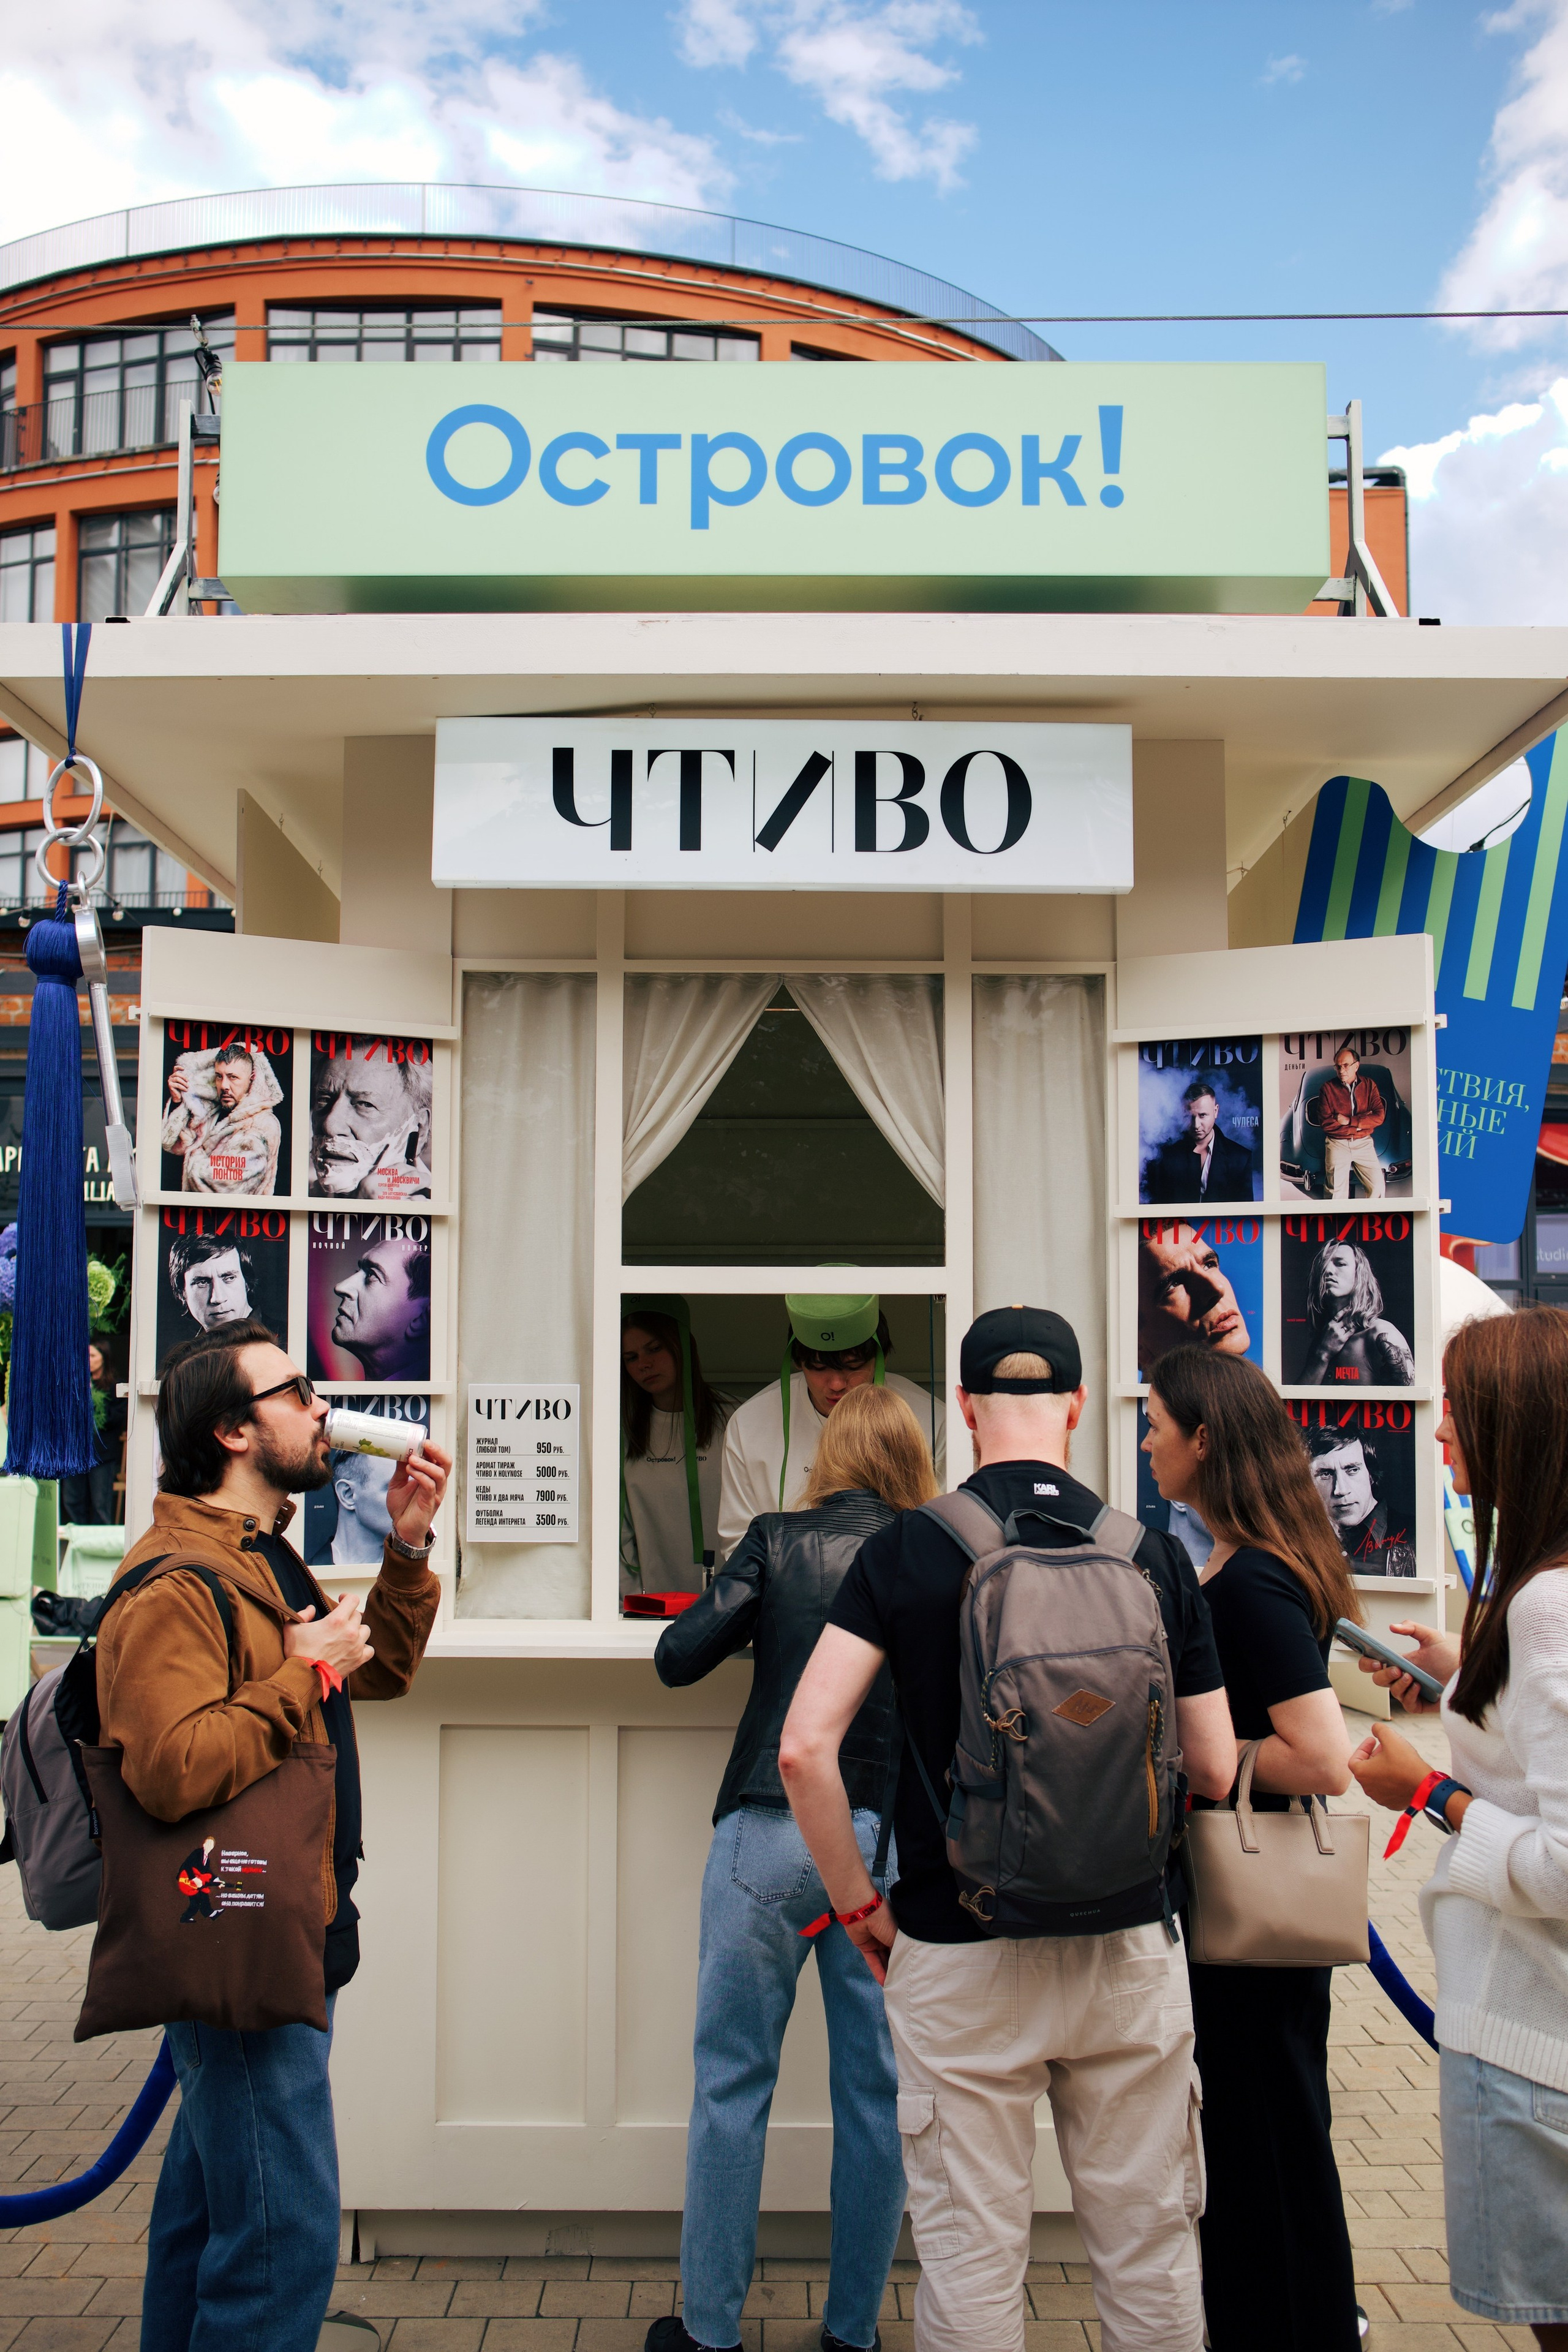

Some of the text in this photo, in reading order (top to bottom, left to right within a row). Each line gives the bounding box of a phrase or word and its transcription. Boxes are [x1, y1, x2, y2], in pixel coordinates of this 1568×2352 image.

[425, 404, 1125, 530] Островок!
[552, 747, 1032, 854] ЧТИВО
[168, 1019, 290, 1055] ЧТИВО
[1284, 1028, 1407, 1060] ЧТИВО
[315, 1031, 429, 1066] ЧТИВО
[1142, 1040, 1259, 1068] ЧТИВО
[1232, 1117, 1259, 1128] ЧУДЕСА
[210, 1155, 246, 1168] ИСТОРИЯ
[213, 1168, 243, 1180] ПОНТОВ
[377, 1167, 398, 1176] МОСКВА
[392, 1176, 420, 1185] МОСКВИЧИ
[164, 1206, 286, 1238] ЧТИВО
[312, 1213, 428, 1243] ЧТИВО
[1286, 1213, 1410, 1243] ЧТИВО
[1142, 1218, 1261, 1245] ЧТИВО
[1335, 1366, 1359, 1380] МЕЧТА
[326, 1395, 427, 1422] ТИВО
[475, 1399, 571, 1420] ЧТИВО
[476, 1444, 497, 1453] (ЛЮБОЙ
[537, 1442, 551, 1453] 950
[537, 1466, 556, 1477] 5000
[1034, 1483, 1057, 1491] KARL
[536, 1490, 556, 1501] 7900
[536, 1514, 556, 1525] 3500
[1070, 1909, 1101, 1917] QUECHUA
